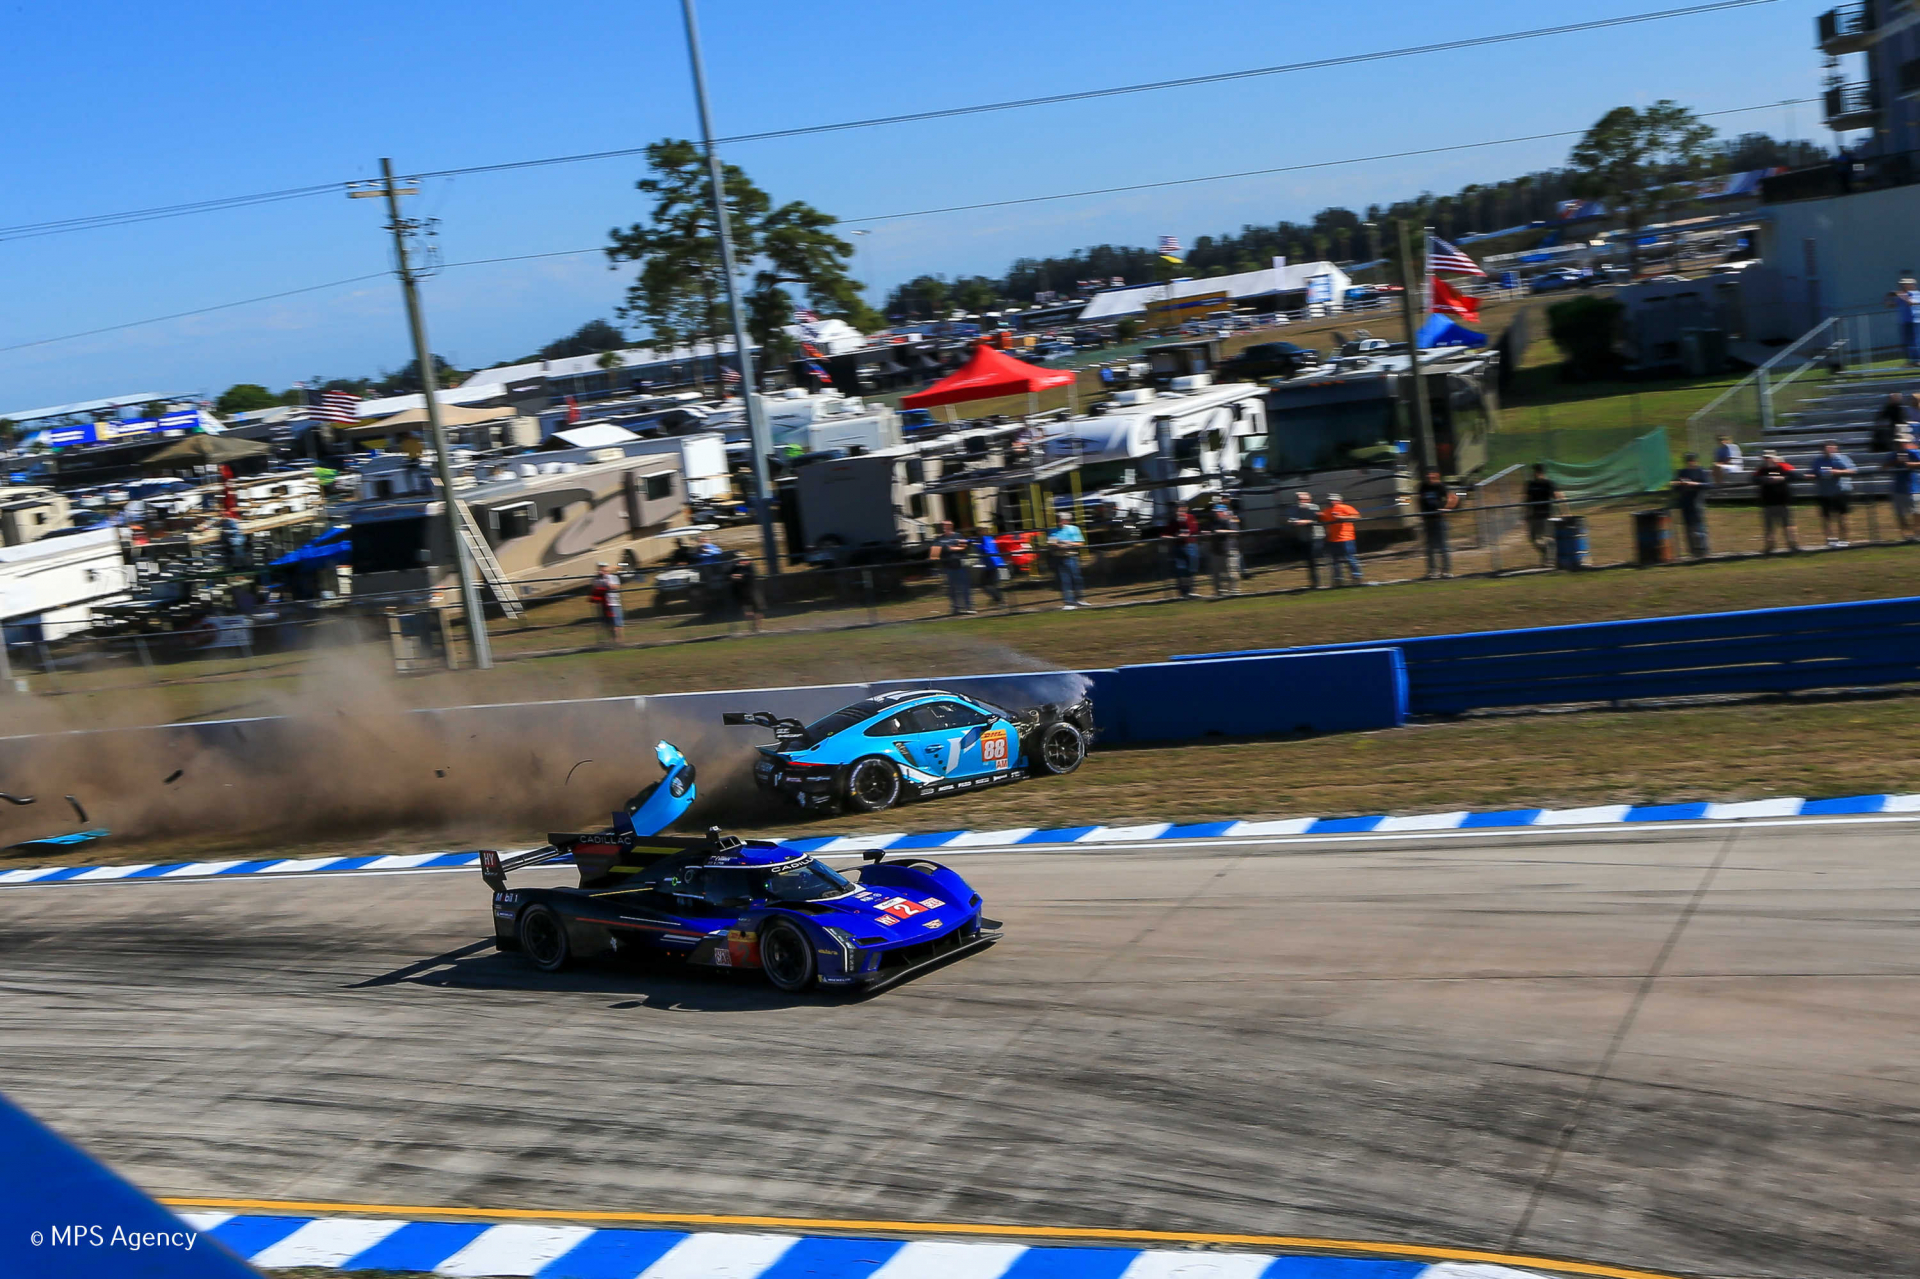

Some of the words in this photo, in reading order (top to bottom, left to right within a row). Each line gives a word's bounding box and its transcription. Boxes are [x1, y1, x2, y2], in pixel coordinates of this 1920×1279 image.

[984, 739, 1006, 760] 88
[996, 760, 1008, 769] AM
[579, 835, 632, 845] CADILLAC
[483, 852, 495, 866] HY
[893, 904, 920, 916] 2
[737, 943, 754, 966] 2
